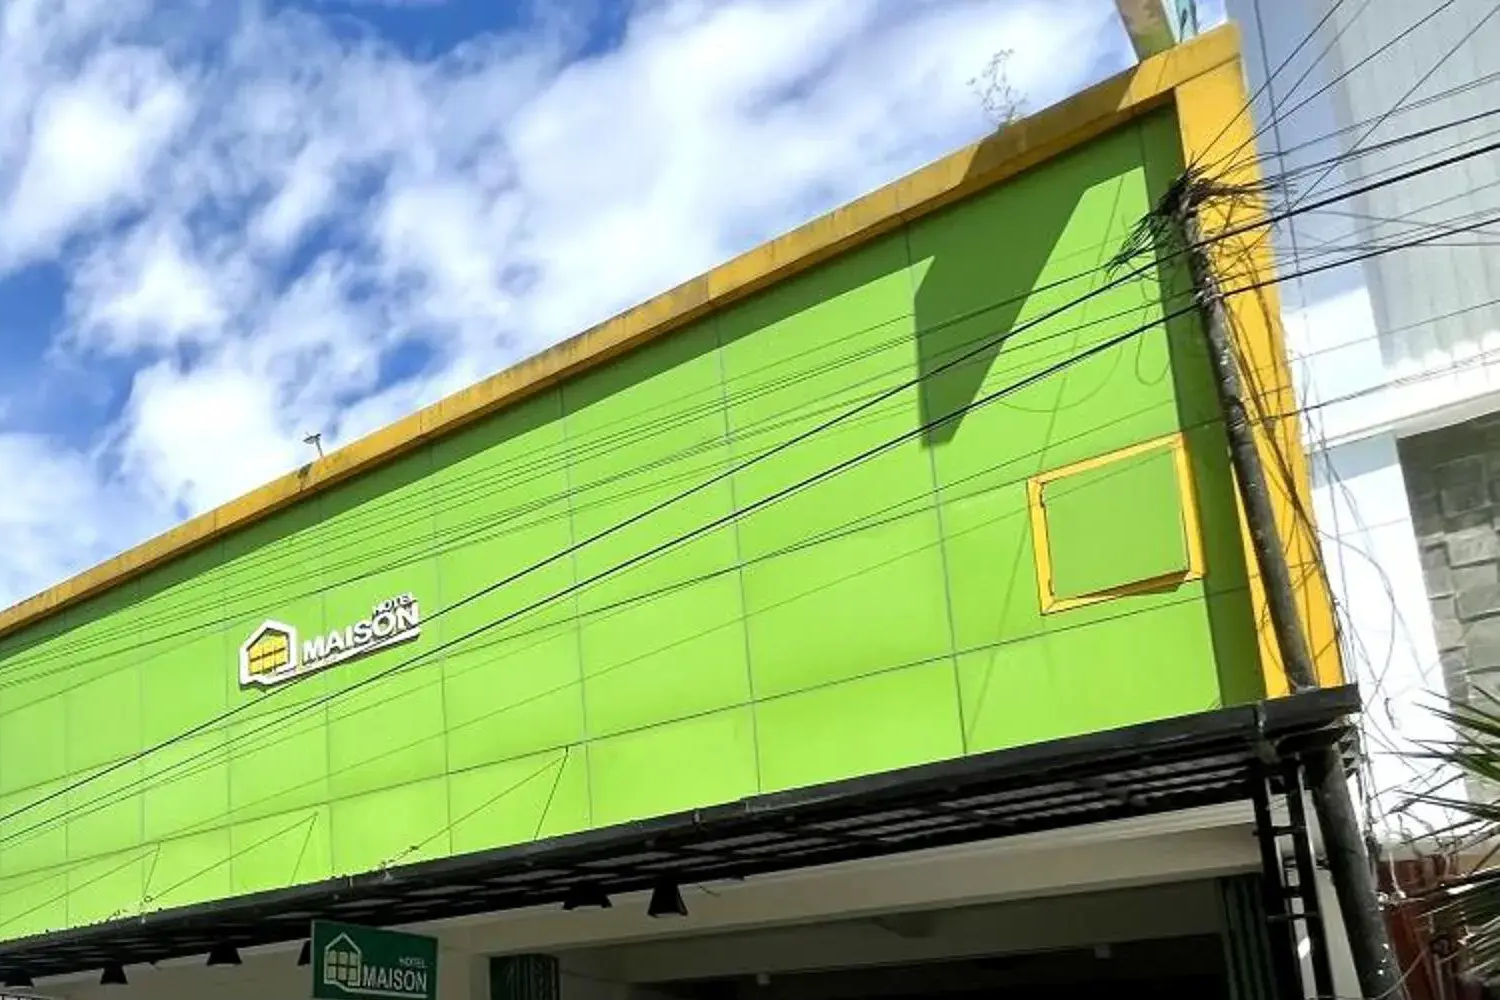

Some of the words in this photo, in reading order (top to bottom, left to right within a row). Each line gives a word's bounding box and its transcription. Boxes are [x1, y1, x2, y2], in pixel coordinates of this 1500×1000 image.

[371, 591, 415, 616] HOTEL
[302, 602, 420, 663] MAISON
[362, 963, 428, 993] MAISON
